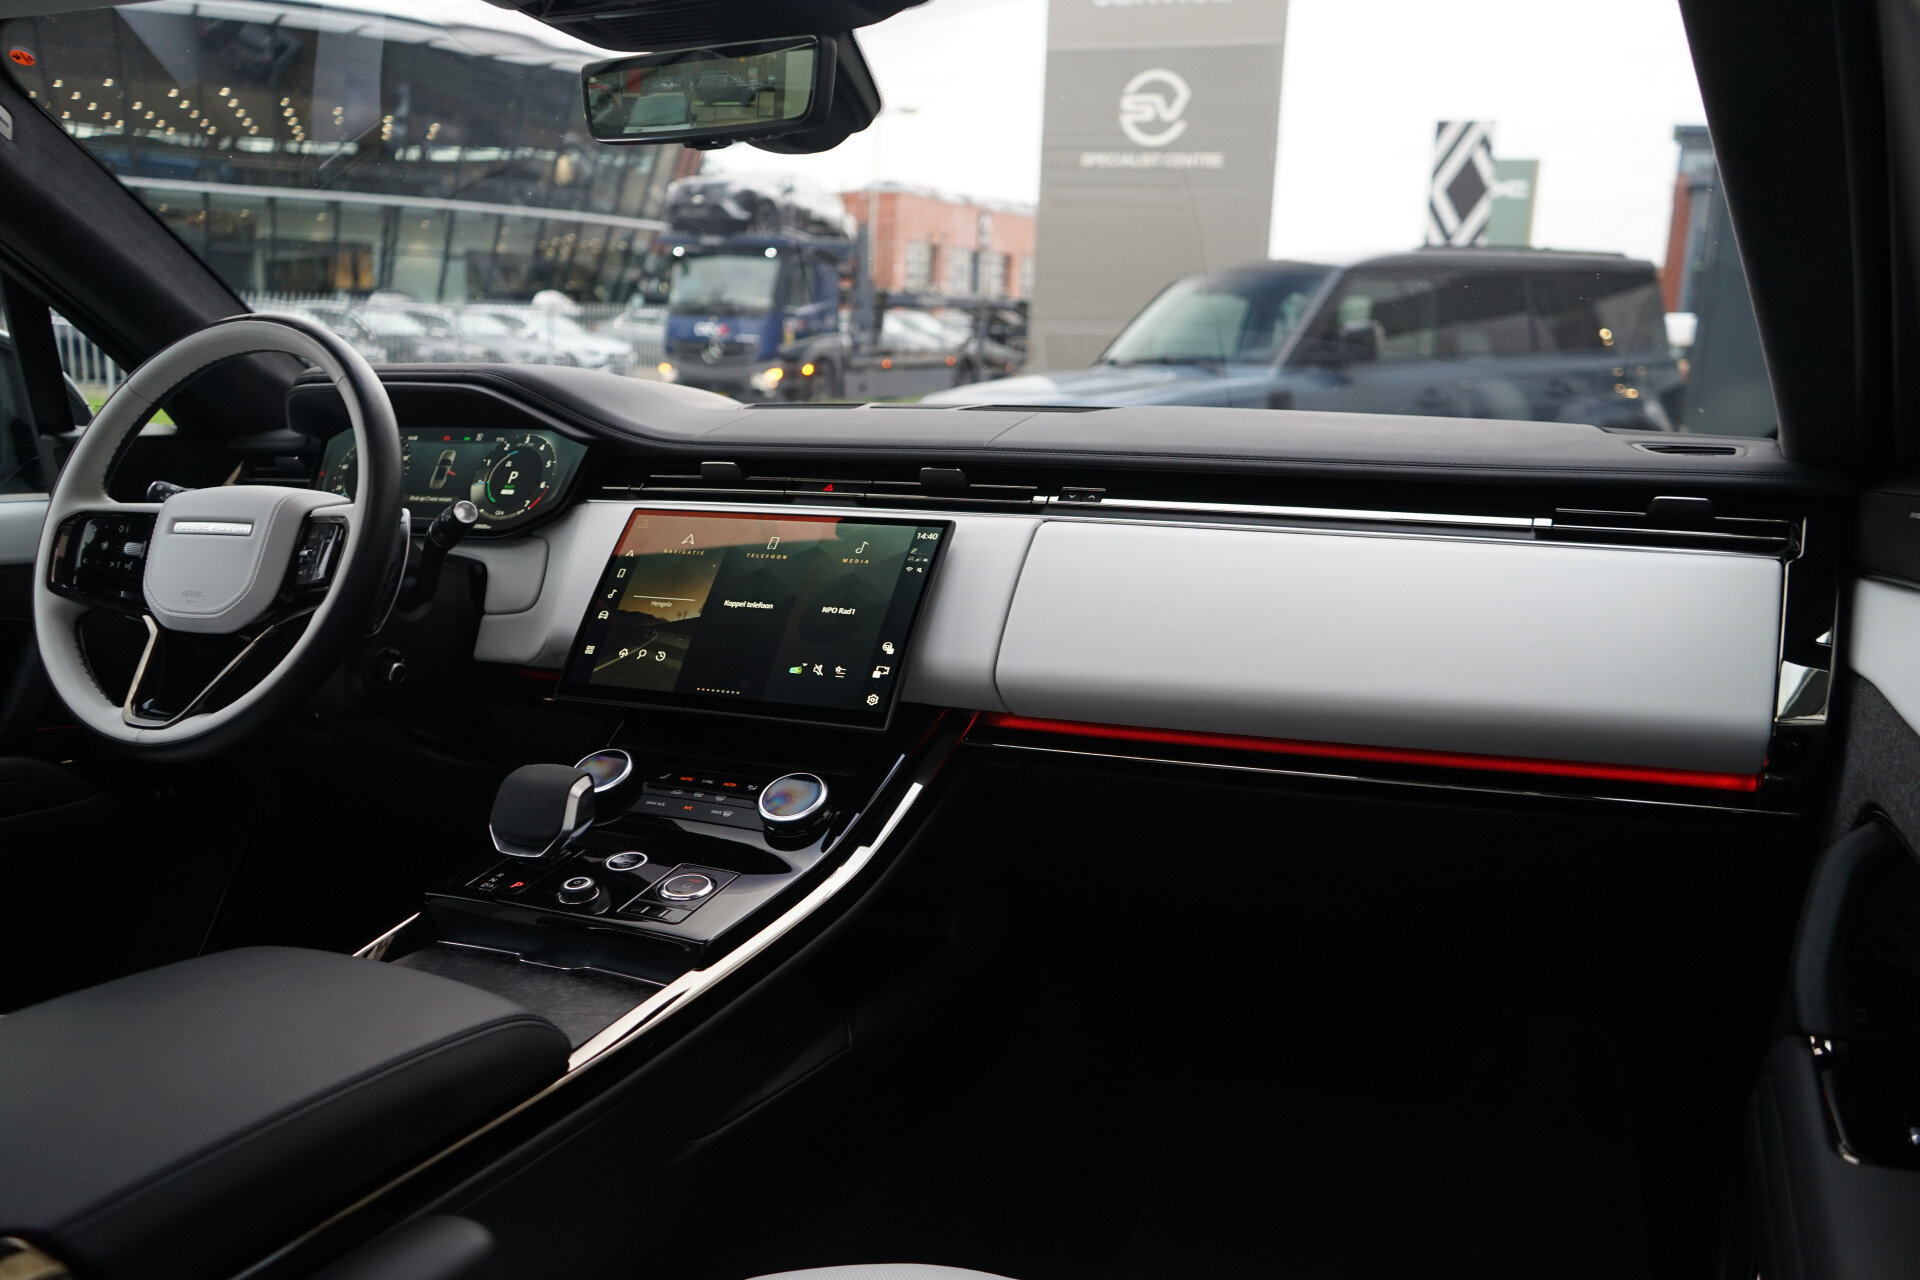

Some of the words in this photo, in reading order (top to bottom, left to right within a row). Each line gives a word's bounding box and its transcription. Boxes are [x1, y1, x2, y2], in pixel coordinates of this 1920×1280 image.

[1079, 151, 1161, 169] SPECIALIST
[507, 471, 519, 484] P
[916, 532, 939, 541] 14:40
[663, 548, 705, 556] NAVIGATIE
[746, 552, 788, 560] TELEFOON
[723, 599, 746, 609] Koppel
[746, 601, 774, 610] telefoon
[821, 606, 838, 614] NPO
[510, 881, 524, 889] P
